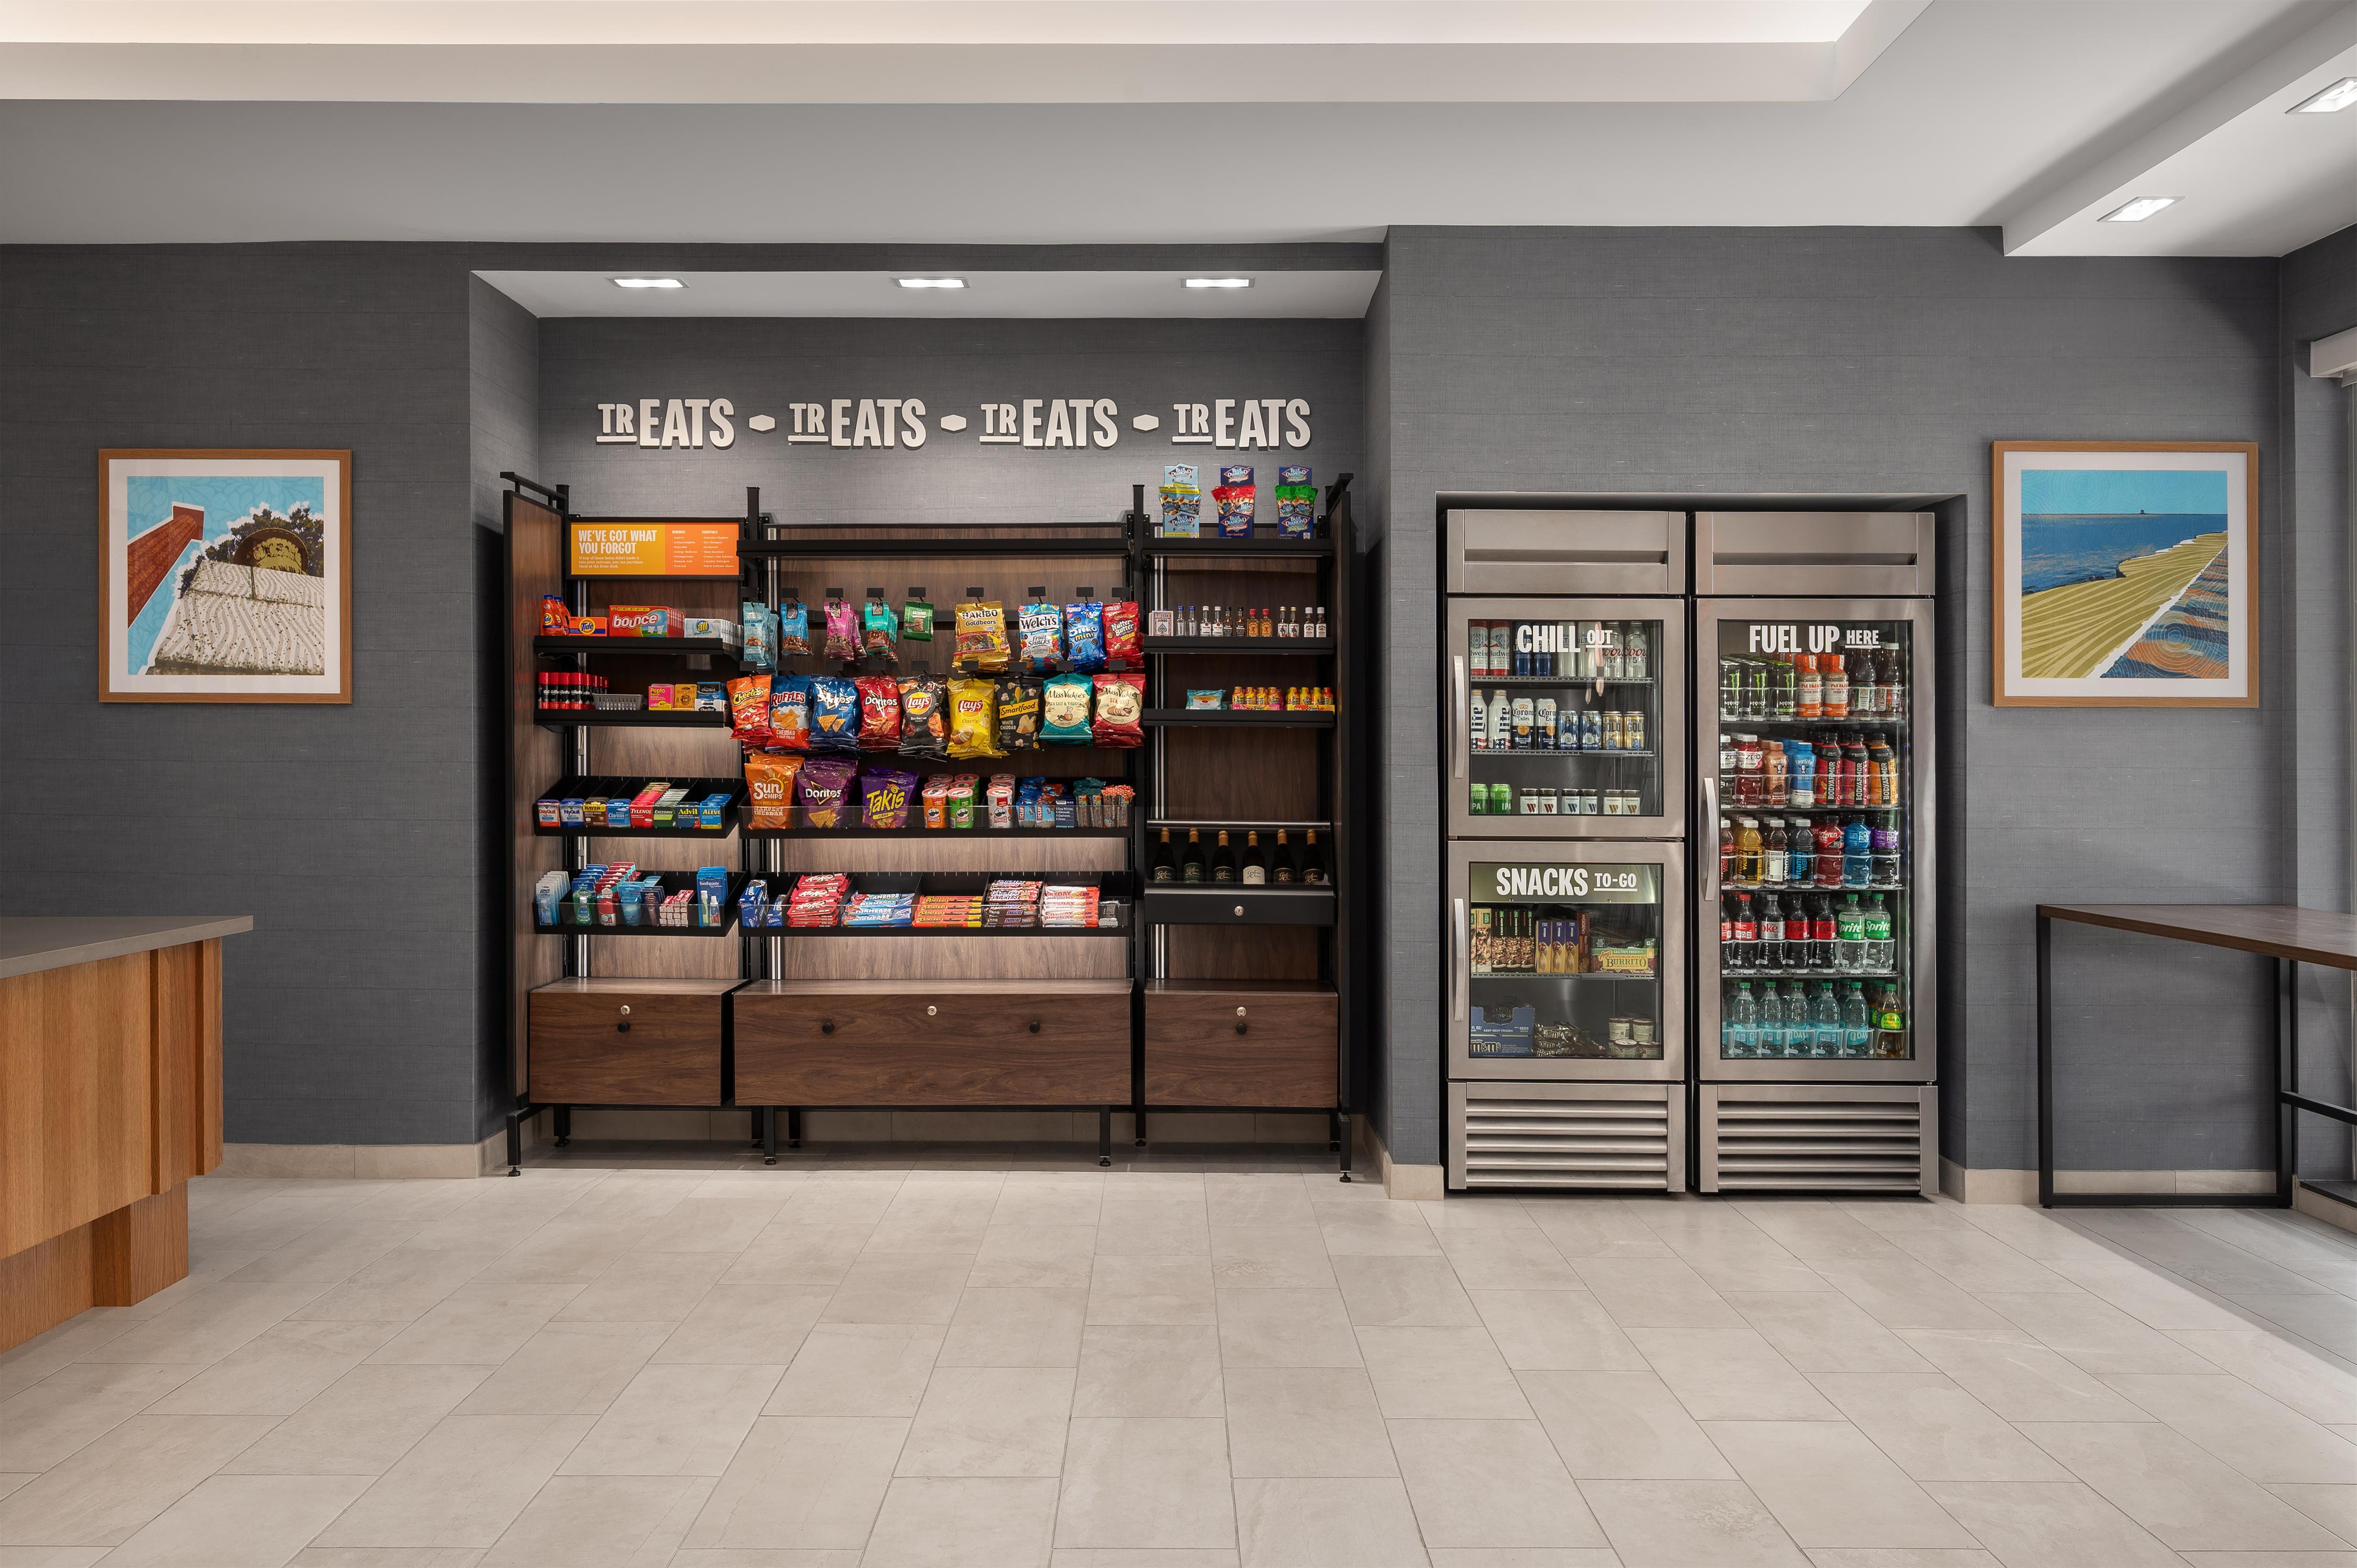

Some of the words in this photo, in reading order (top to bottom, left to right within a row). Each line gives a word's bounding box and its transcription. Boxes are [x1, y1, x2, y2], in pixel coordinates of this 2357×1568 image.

[578, 530, 607, 542] WE'VE
[609, 530, 628, 542] GOT
[630, 530, 657, 542] WHAT
[579, 542, 598, 554] YOU
[600, 542, 637, 554] FORGOT
[962, 610, 998, 619] HARIBO
[581, 622, 593, 632] Tide
[613, 614, 658, 629] bounce
[697, 621, 708, 632] all
[1021, 617, 1057, 630] Welch's
[1111, 619, 1132, 630] Nutter
[1069, 626, 1097, 637] OREO
[1113, 625, 1135, 636] Butter
[1121, 632, 1135, 641] Bites
[1074, 633, 1094, 641] mini
[1517, 625, 1581, 653] CHILL
[1587, 630, 1613, 644] OUT
[1750, 625, 1802, 653] FUEL
[1808, 625, 1840, 653] UP
[1846, 630, 1879, 644] HERE
[1028, 639, 1050, 648] Snacks
[732, 687, 763, 706] Cheetos
[771, 692, 805, 705] RUFFLES
[865, 697, 898, 706] Doritos
[907, 697, 930, 713] Lay's
[960, 700, 983, 715] Lay's
[1001, 702, 1036, 718] Smartfood
[1746, 754, 1761, 763] ZERO
[1795, 759, 1813, 768] fairlife
[1881, 762, 1889, 800] BODYARMOR
[753, 782, 784, 800] Sun
[805, 788, 842, 798] Doritos
[867, 785, 905, 816] Takis
[1496, 868, 1588, 896] SNACKS
[1594, 873, 1637, 888] TO-GO
[1864, 920, 1891, 932] Sprite
[1599, 951, 1612, 961] Amy's
[1606, 958, 1647, 968] BURRITO
